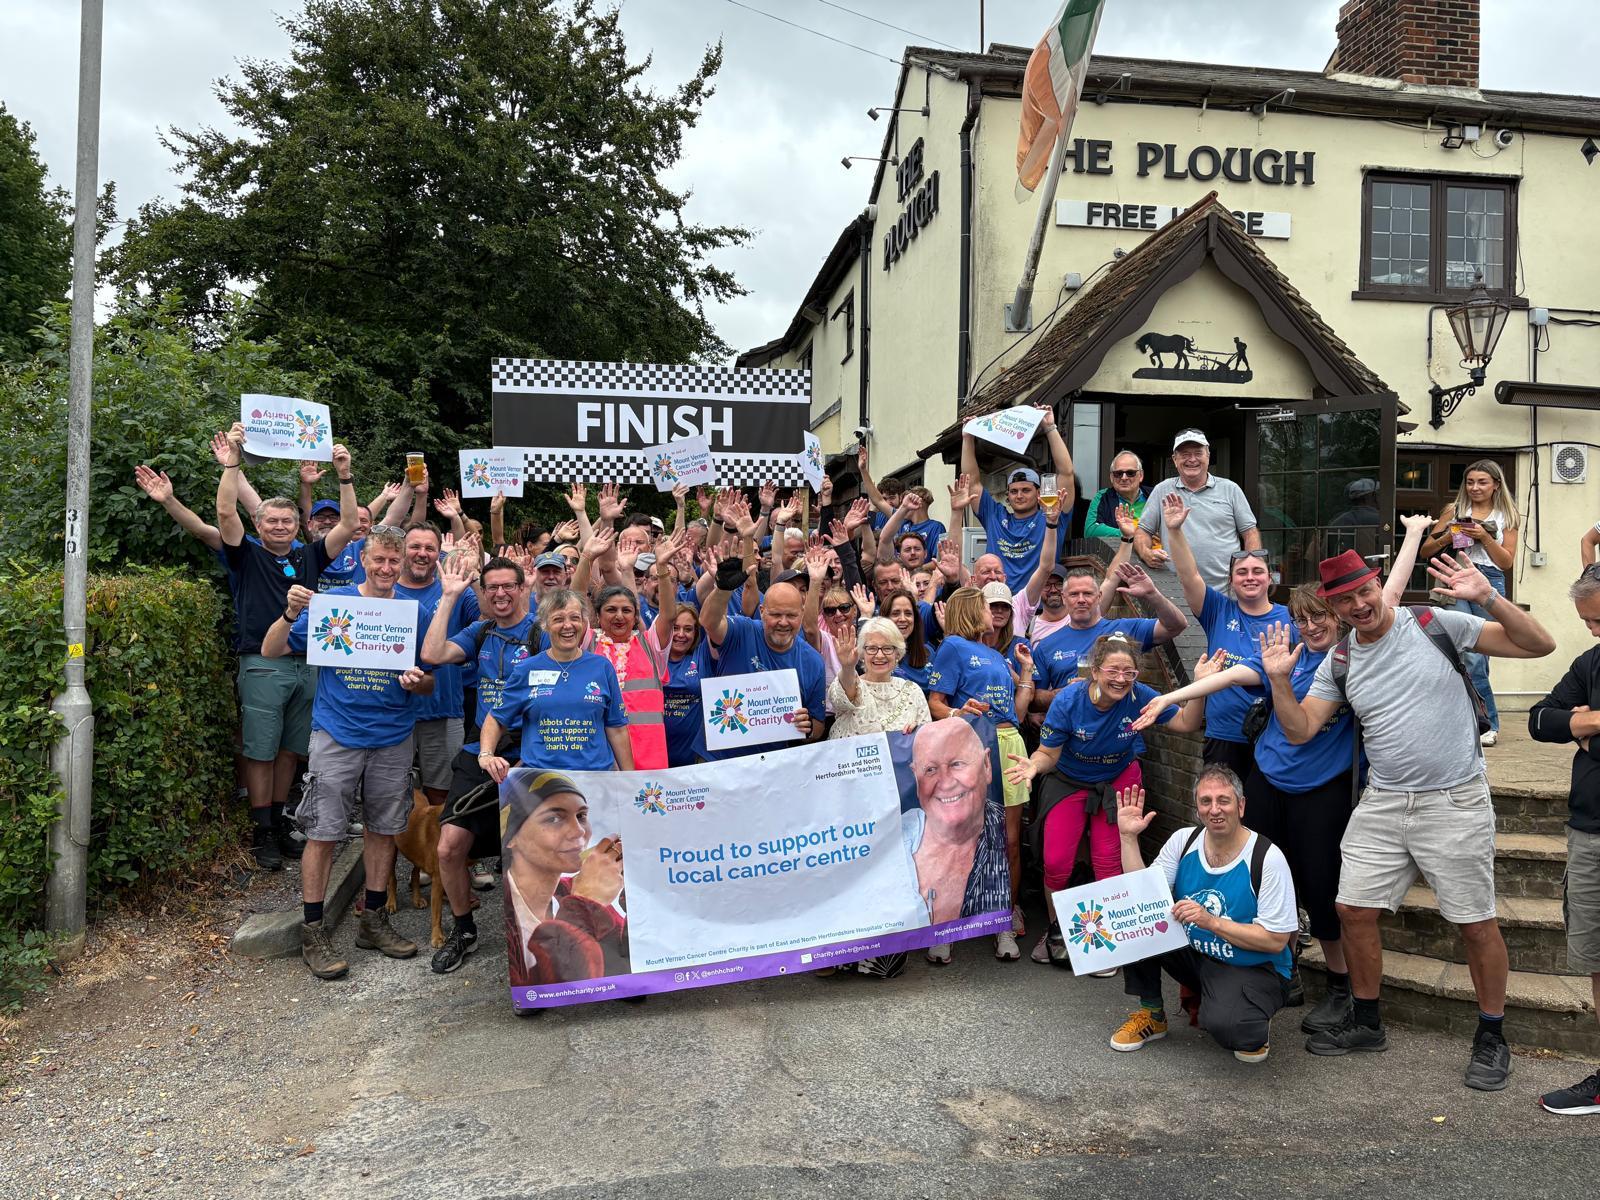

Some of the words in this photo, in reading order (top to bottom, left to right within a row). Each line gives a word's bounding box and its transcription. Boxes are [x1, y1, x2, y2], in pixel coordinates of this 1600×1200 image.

[1061, 138, 1113, 175] HE
[1137, 142, 1316, 185] PLOUGH
[896, 136, 924, 203] THE
[883, 170, 940, 271] PLOUGH
[1087, 202, 1158, 229] FREE
[263, 410, 295, 422] Charity
[251, 419, 273, 427] Centre
[274, 422, 295, 430] Cancer
[577, 402, 733, 447] FINISH
[245, 426, 272, 436] Vernon
[272, 428, 295, 438] Mount
[995, 424, 1016, 437] Charity
[690, 452, 709, 460] Vernon
[677, 467, 700, 477] Charity
[490, 478, 512, 486] Charity
[356, 622, 382, 632] Mount
[384, 624, 413, 634] Vernon
[355, 632, 379, 641] Cancer
[381, 633, 406, 643] Centre
[354, 642, 392, 654] Charity
[364, 669, 389, 677] support
[368, 676, 390, 684] Vernon
[348, 682, 370, 691] charity
[747, 698, 772, 708] Mount
[773, 695, 798, 705] Vernon
[748, 707, 770, 717] Cancer
[772, 705, 794, 714] Centre
[540, 718, 563, 726] Abbots
[564, 718, 580, 726] Care
[749, 715, 783, 727] Charity
[546, 743, 569, 751] charity
[858, 746, 878, 758] NHS
[864, 757, 880, 765] North
[816, 769, 856, 780] Hertfordshire
[857, 764, 882, 773] Teaching
[665, 789, 686, 797] Mount
[687, 786, 710, 795] Vernon
[666, 802, 696, 812] Charity
[659, 844, 724, 863] Proud
[730, 842, 752, 860] to
[758, 824, 838, 856] support
[842, 820, 876, 839] our
[668, 865, 723, 884] local
[727, 857, 800, 880] cancer
[805, 844, 872, 868] centre
[1122, 890, 1129, 898] of
[1108, 906, 1137, 920] Mount
[1137, 899, 1170, 913] Vernon
[1111, 918, 1137, 931] Cancer
[1138, 912, 1166, 924] Centre
[934, 926, 962, 936] Registered
[963, 922, 982, 930] charity
[1115, 926, 1154, 942] Charity
[645, 958, 664, 966] Mount
[665, 955, 686, 963] Vernon
[687, 952, 707, 960] Cancer
[728, 946, 748, 954] Charity
[756, 943, 768, 951] part
[801, 935, 817, 943] North
[818, 928, 855, 940] Hertfordshire
[701, 965, 744, 978] @enhhcharity
[539, 984, 616, 998] www.enhhcharity.org.uk
